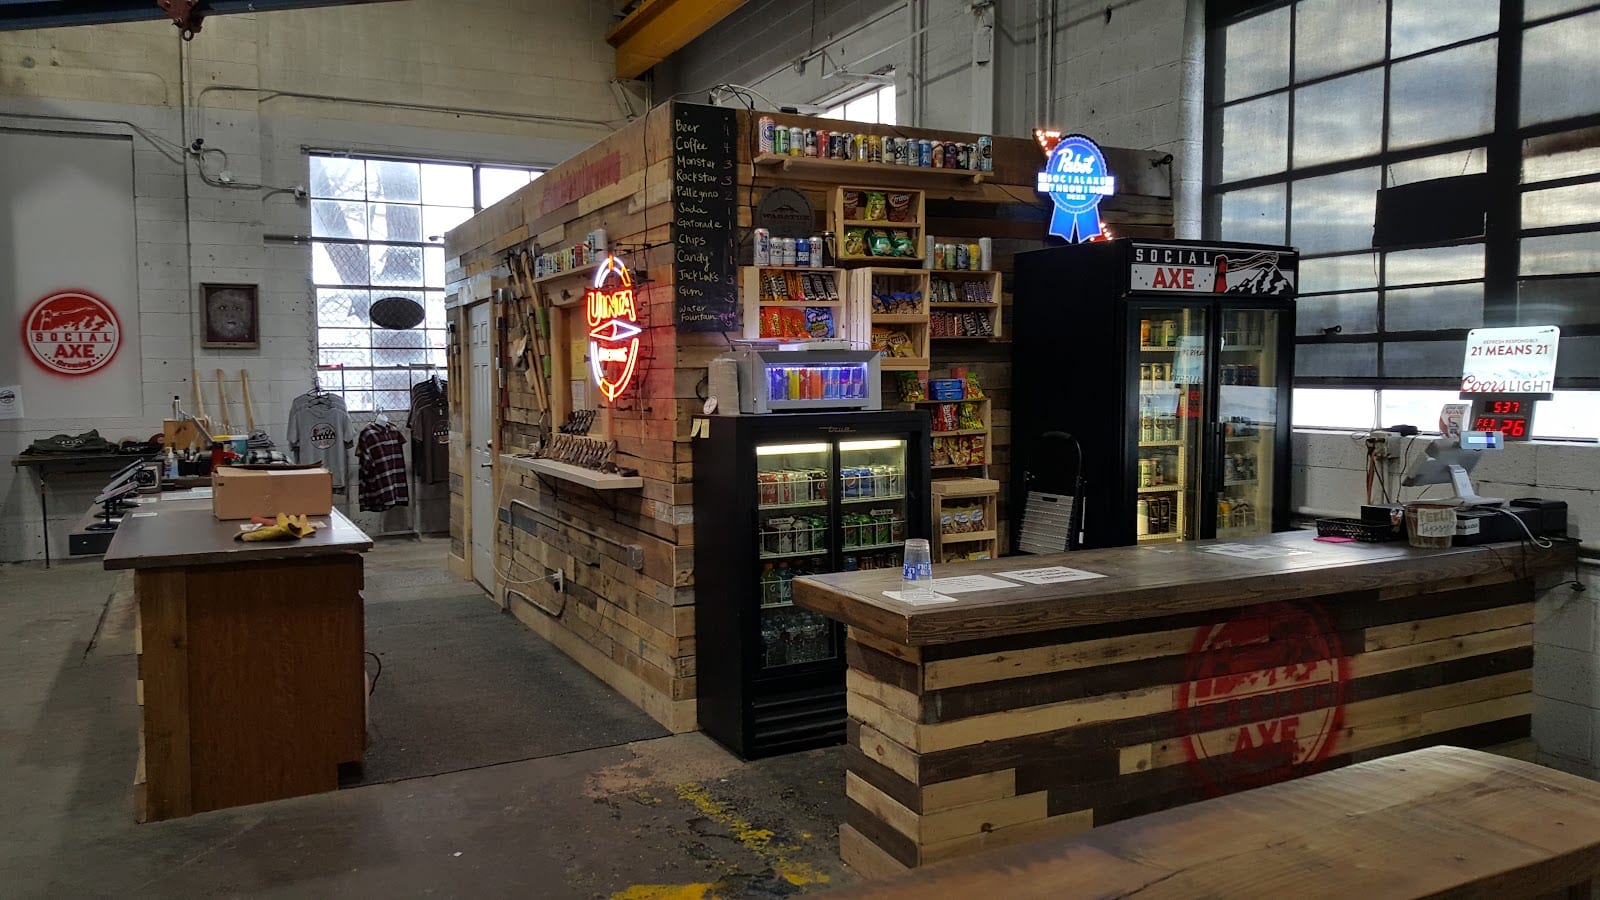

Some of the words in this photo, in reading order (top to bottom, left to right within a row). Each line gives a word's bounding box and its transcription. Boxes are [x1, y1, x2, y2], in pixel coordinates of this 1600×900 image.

[675, 119, 701, 133] Beer
[675, 135, 708, 154] Coffee
[676, 154, 716, 169] Monster
[723, 159, 733, 169] 3
[1056, 147, 1096, 174] Pabst
[676, 168, 717, 183] Rockstar
[720, 175, 733, 186] 3
[678, 201, 708, 214] Soda
[676, 217, 722, 229] Gatorade
[678, 233, 706, 247] Chips
[677, 249, 709, 272] Candy
[1135, 248, 1211, 265] SOCIAL
[678, 269, 699, 281] Jack
[1152, 267, 1195, 290] AXE
[678, 285, 704, 297] Gum
[587, 289, 637, 327] UINTA
[679, 304, 706, 313] Water
[681, 312, 719, 323] Fountain
[35, 332, 112, 343] SOCIAL
[54, 343, 95, 358] AXE
[1471, 346, 1482, 356] 21
[1485, 344, 1532, 356] MEANS
[1535, 344, 1548, 355] 21
[1461, 375, 1507, 393] Coors
[1508, 381, 1552, 392] LIGHT
[1500, 419, 1525, 437] 26
[1232, 716, 1301, 760] AXE
